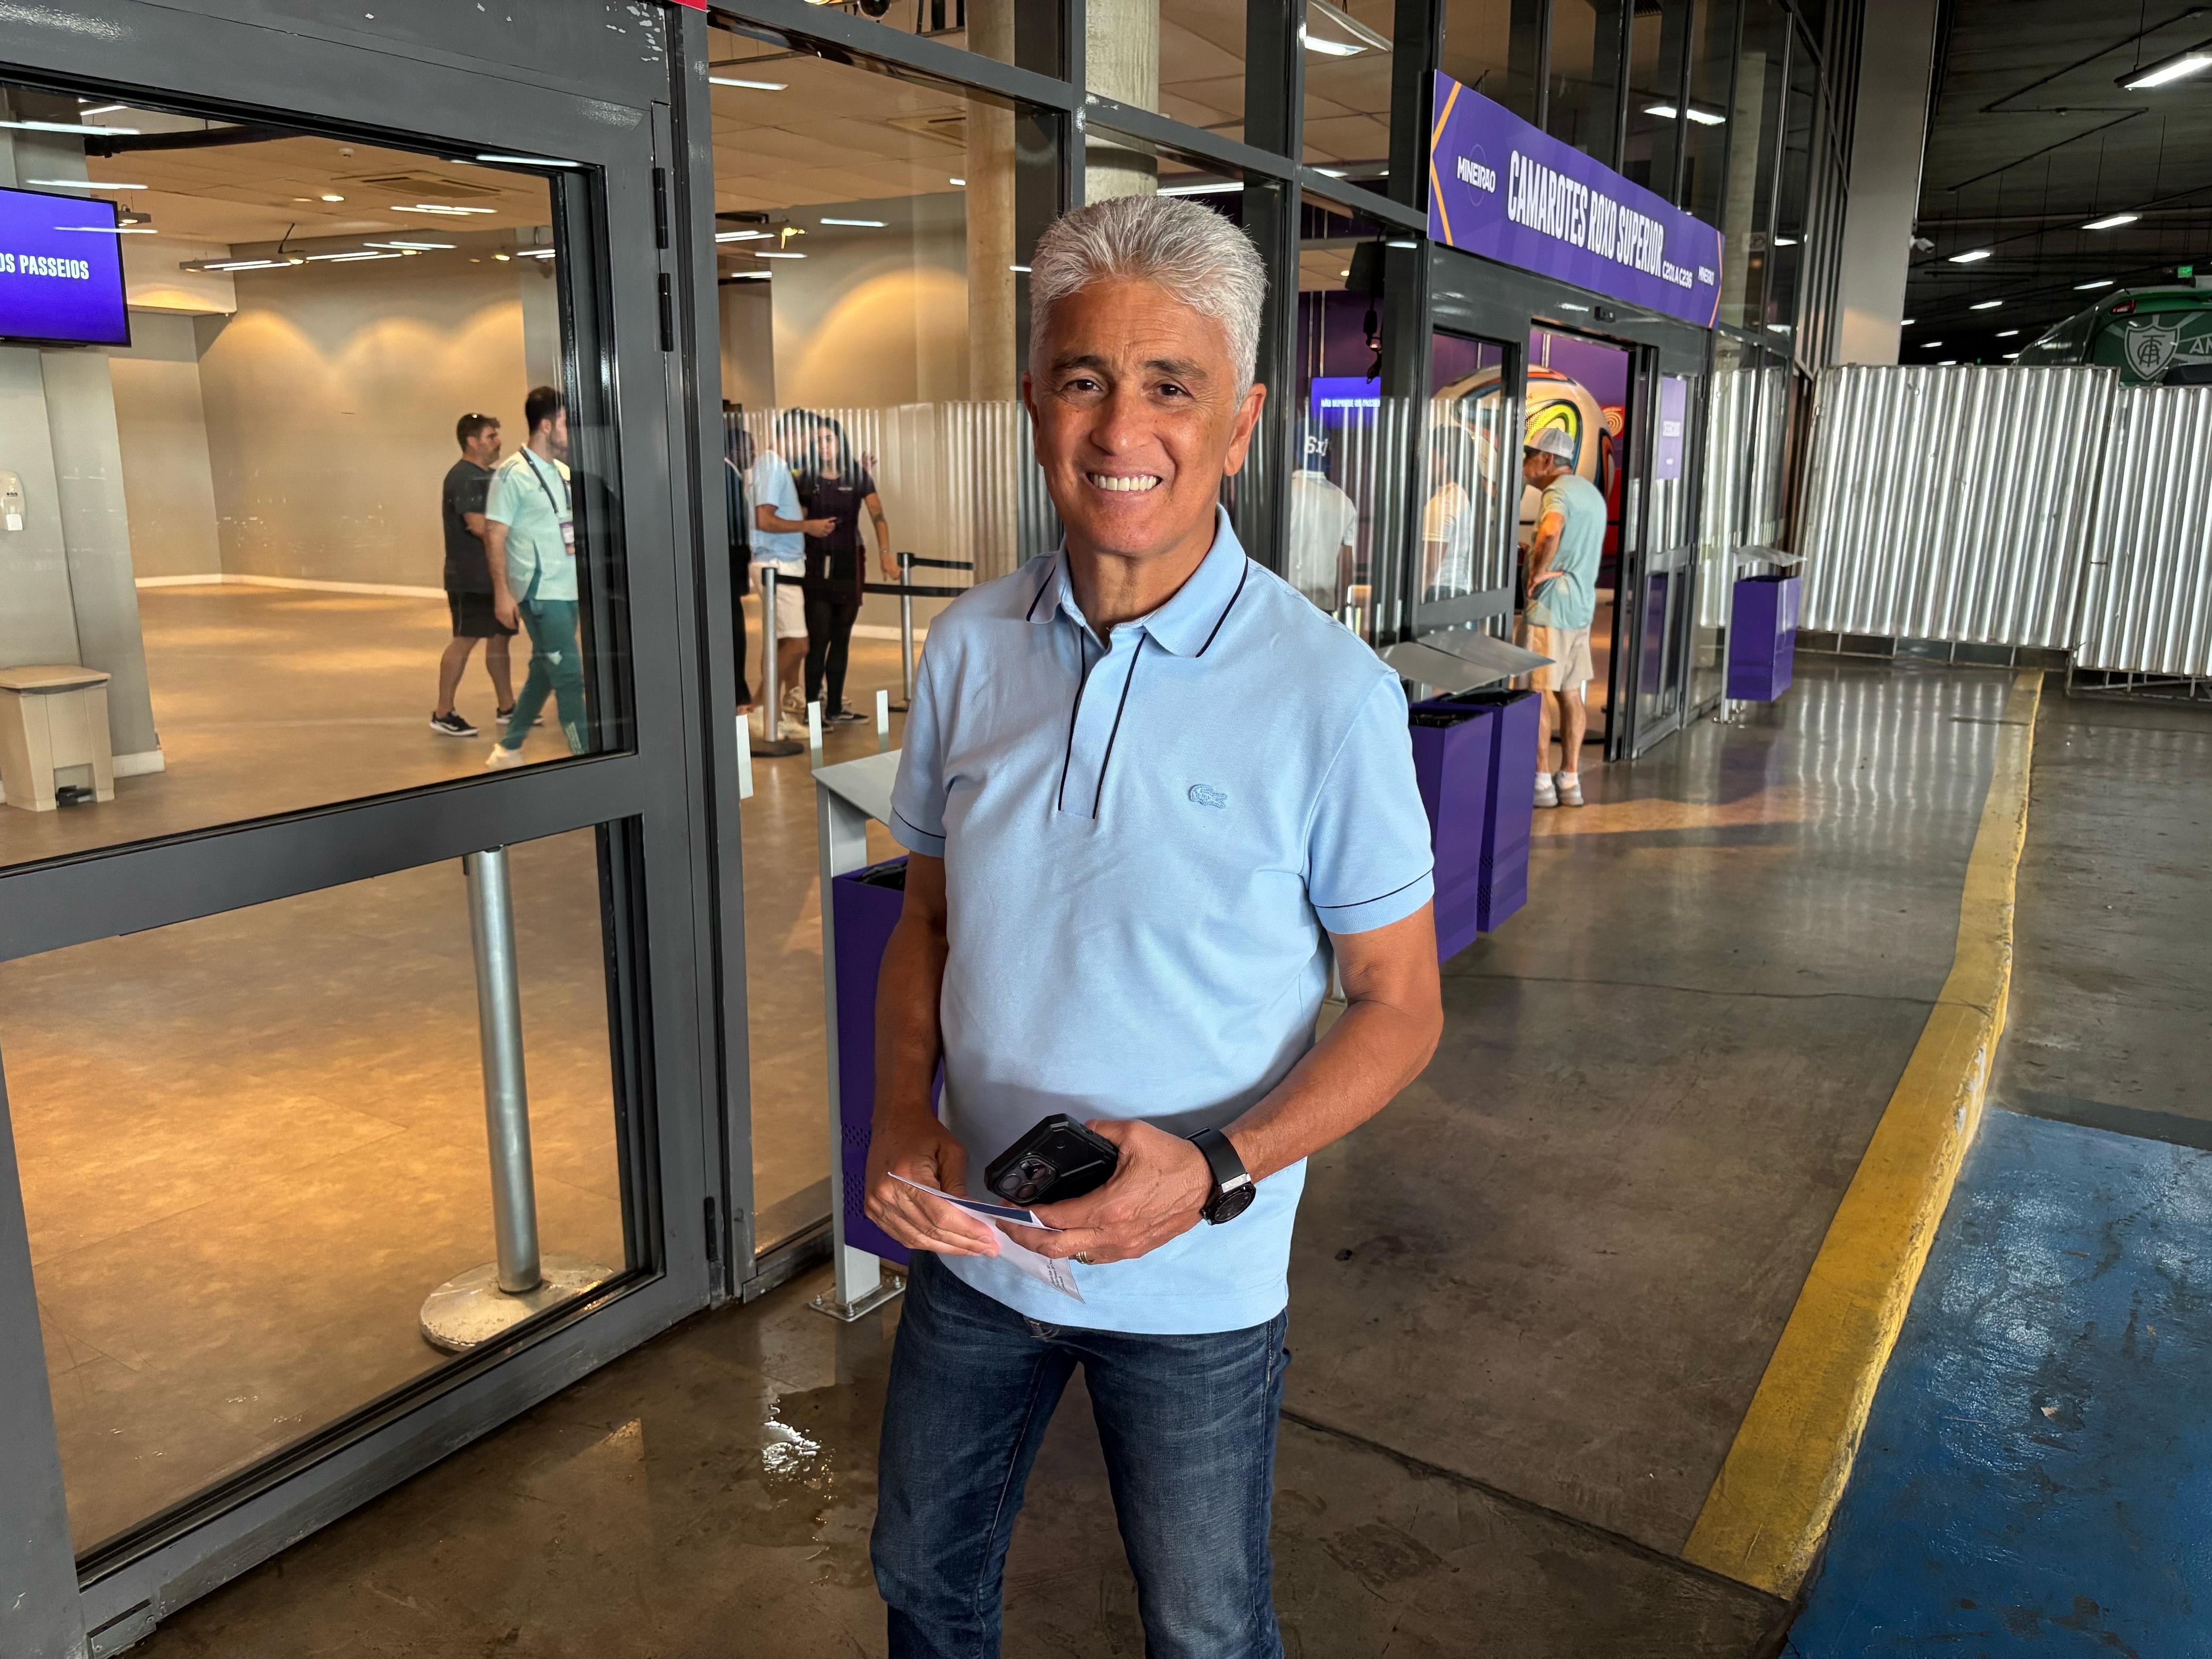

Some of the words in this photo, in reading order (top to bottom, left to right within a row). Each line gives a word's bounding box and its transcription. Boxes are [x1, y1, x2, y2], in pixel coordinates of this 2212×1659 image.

[1508, 150, 1588, 248] CAMAROTES
[1587, 190, 1617, 259] ROXO
[1616, 206, 1664, 277] SUPERIOR
[19, 255, 89, 280] PASSEIOS
